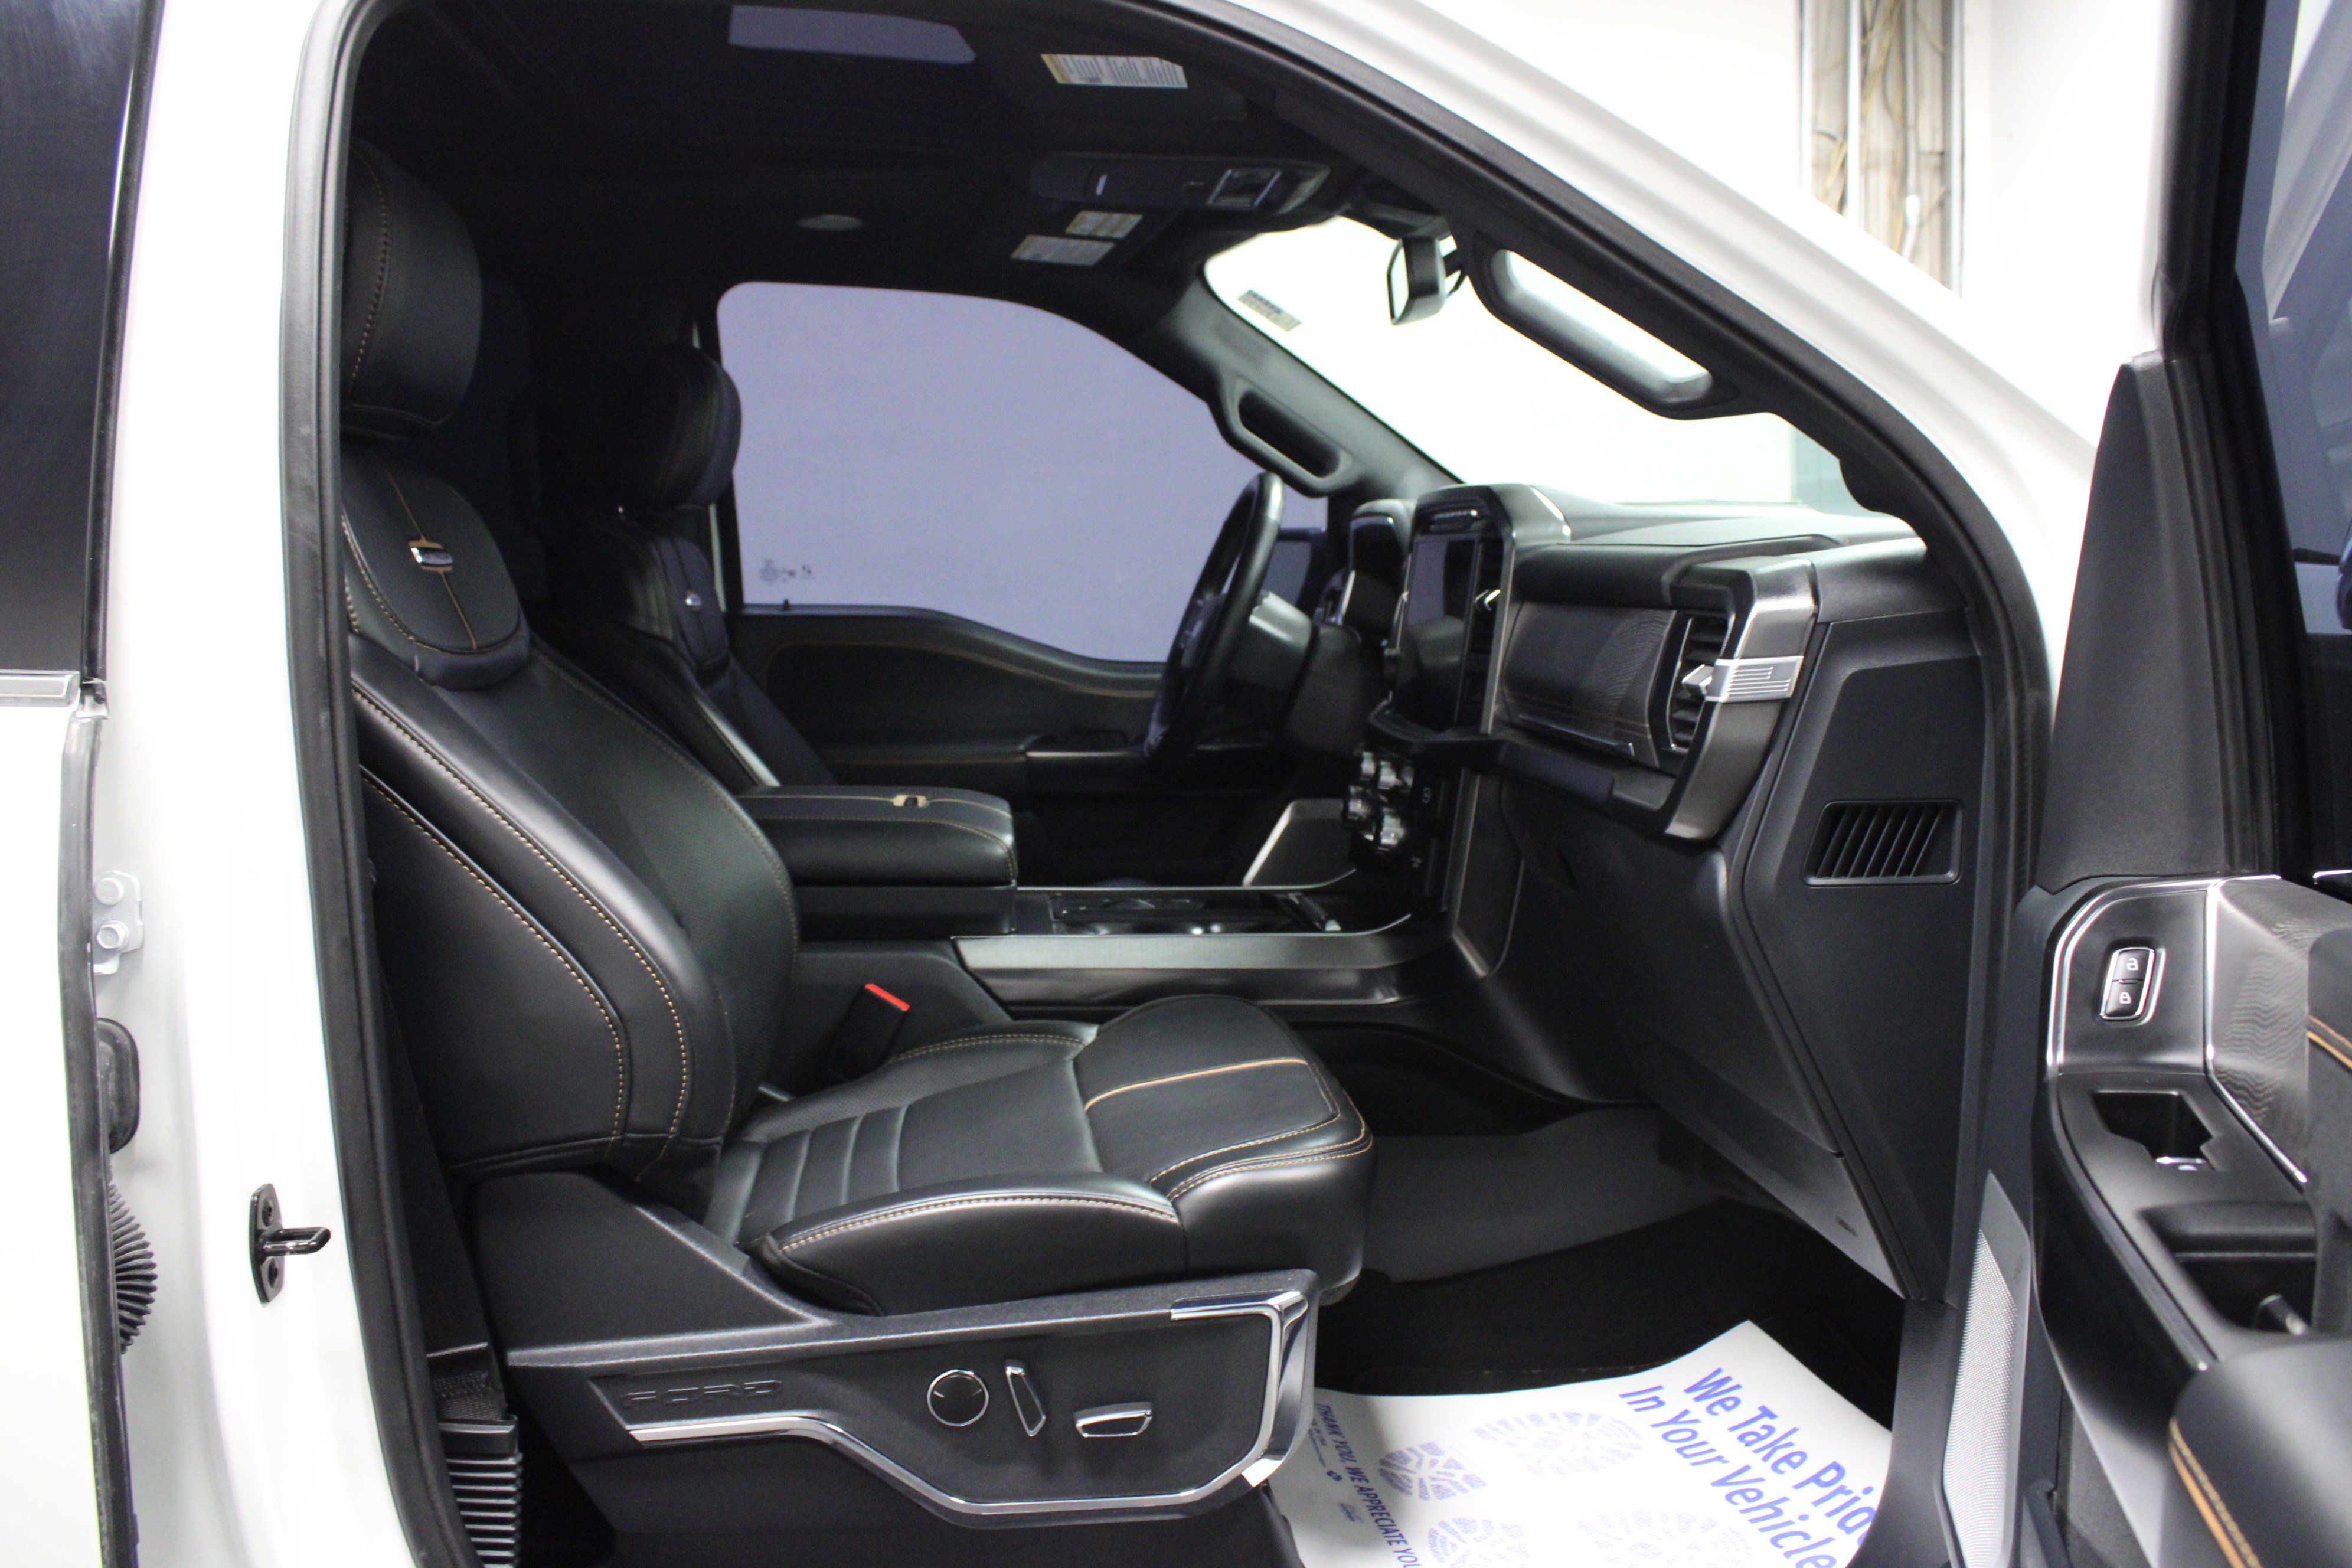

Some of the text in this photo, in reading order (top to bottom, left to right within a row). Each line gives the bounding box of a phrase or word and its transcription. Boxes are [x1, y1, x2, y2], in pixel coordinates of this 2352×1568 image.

[1315, 1403, 1344, 1438] THANK
[1345, 1466, 1370, 1484] WE
[1618, 1384, 1838, 1568] In Your Vehicle
[1683, 1367, 1877, 1546] We Take Prid
[1354, 1485, 1409, 1546] APPRECIATE
